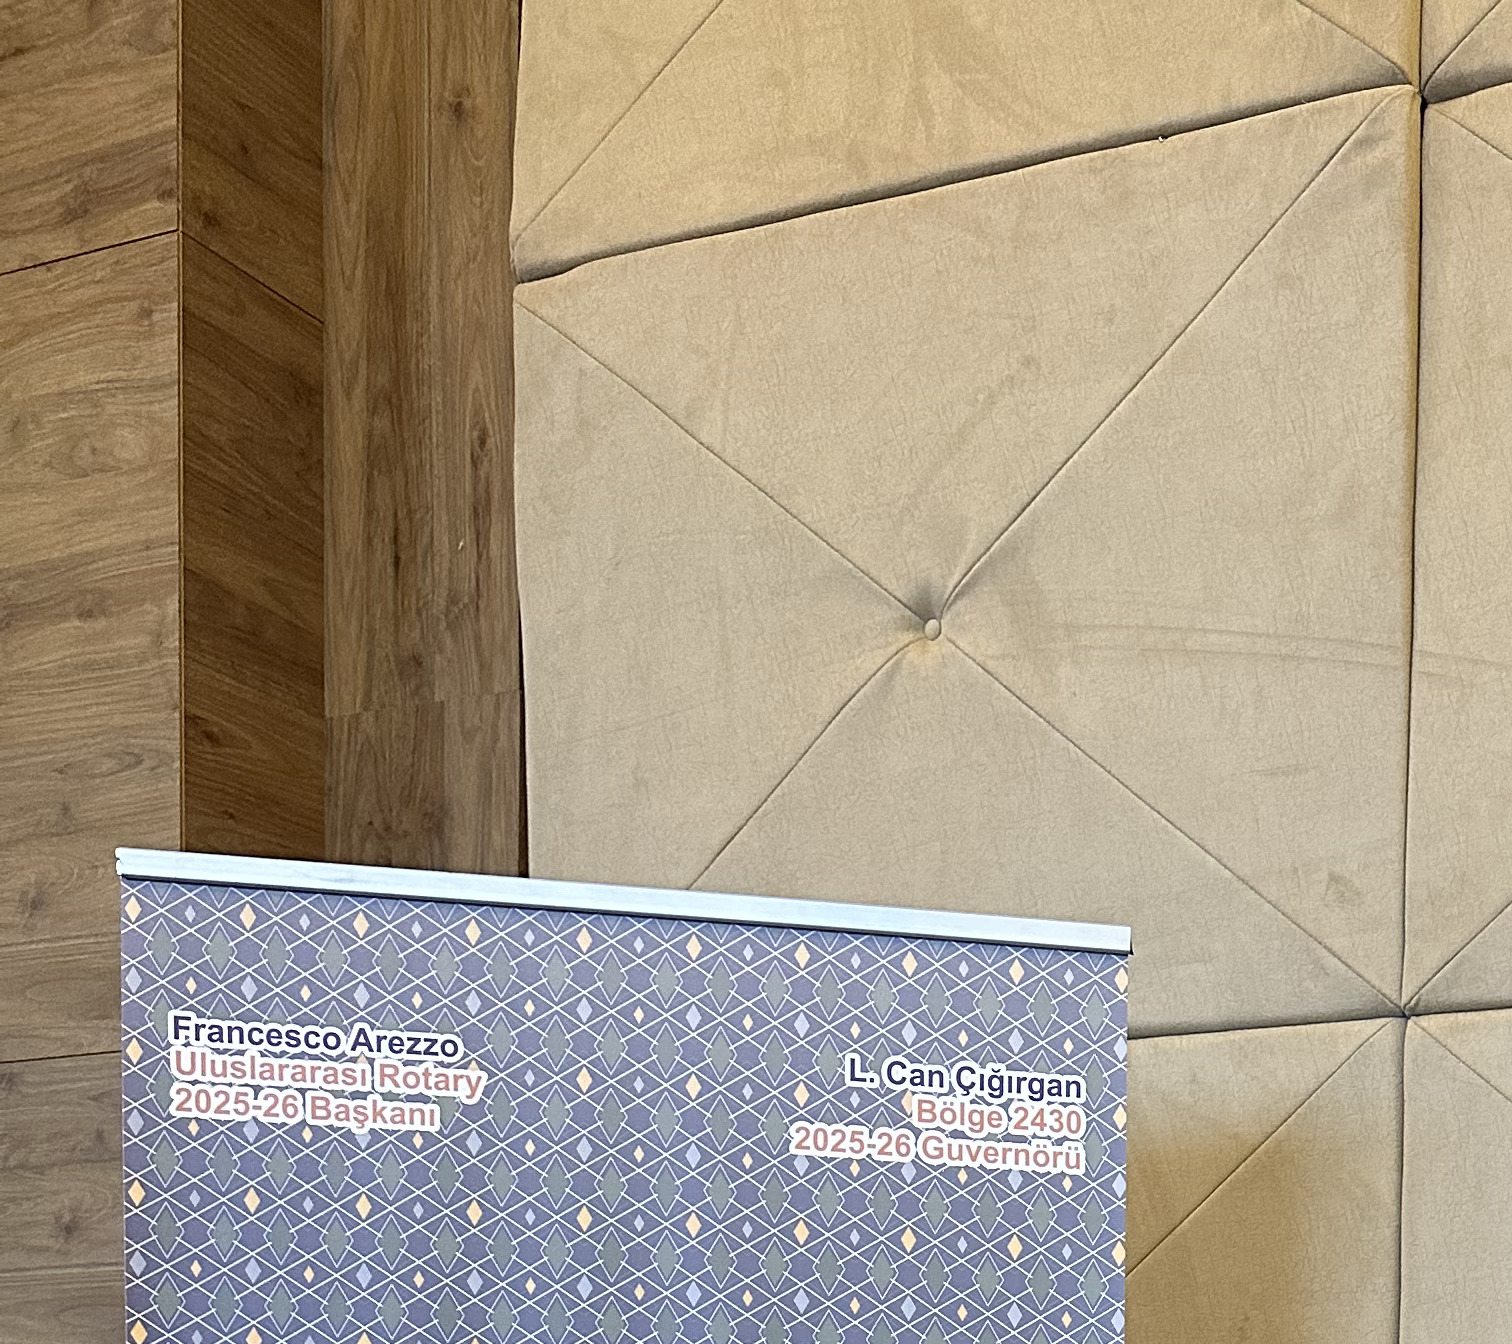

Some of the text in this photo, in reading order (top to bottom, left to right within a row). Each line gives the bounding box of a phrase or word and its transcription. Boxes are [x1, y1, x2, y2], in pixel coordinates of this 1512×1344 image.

[172, 1015, 459, 1058] Francesco Arezzo
[174, 1050, 482, 1099] Uluslararası Rotary
[849, 1057, 1082, 1102] L. Can Çığırgan
[174, 1087, 436, 1129] 2025-26 Başkanı
[917, 1098, 1082, 1135] Bölge 2430
[794, 1126, 911, 1158] 2025-26
